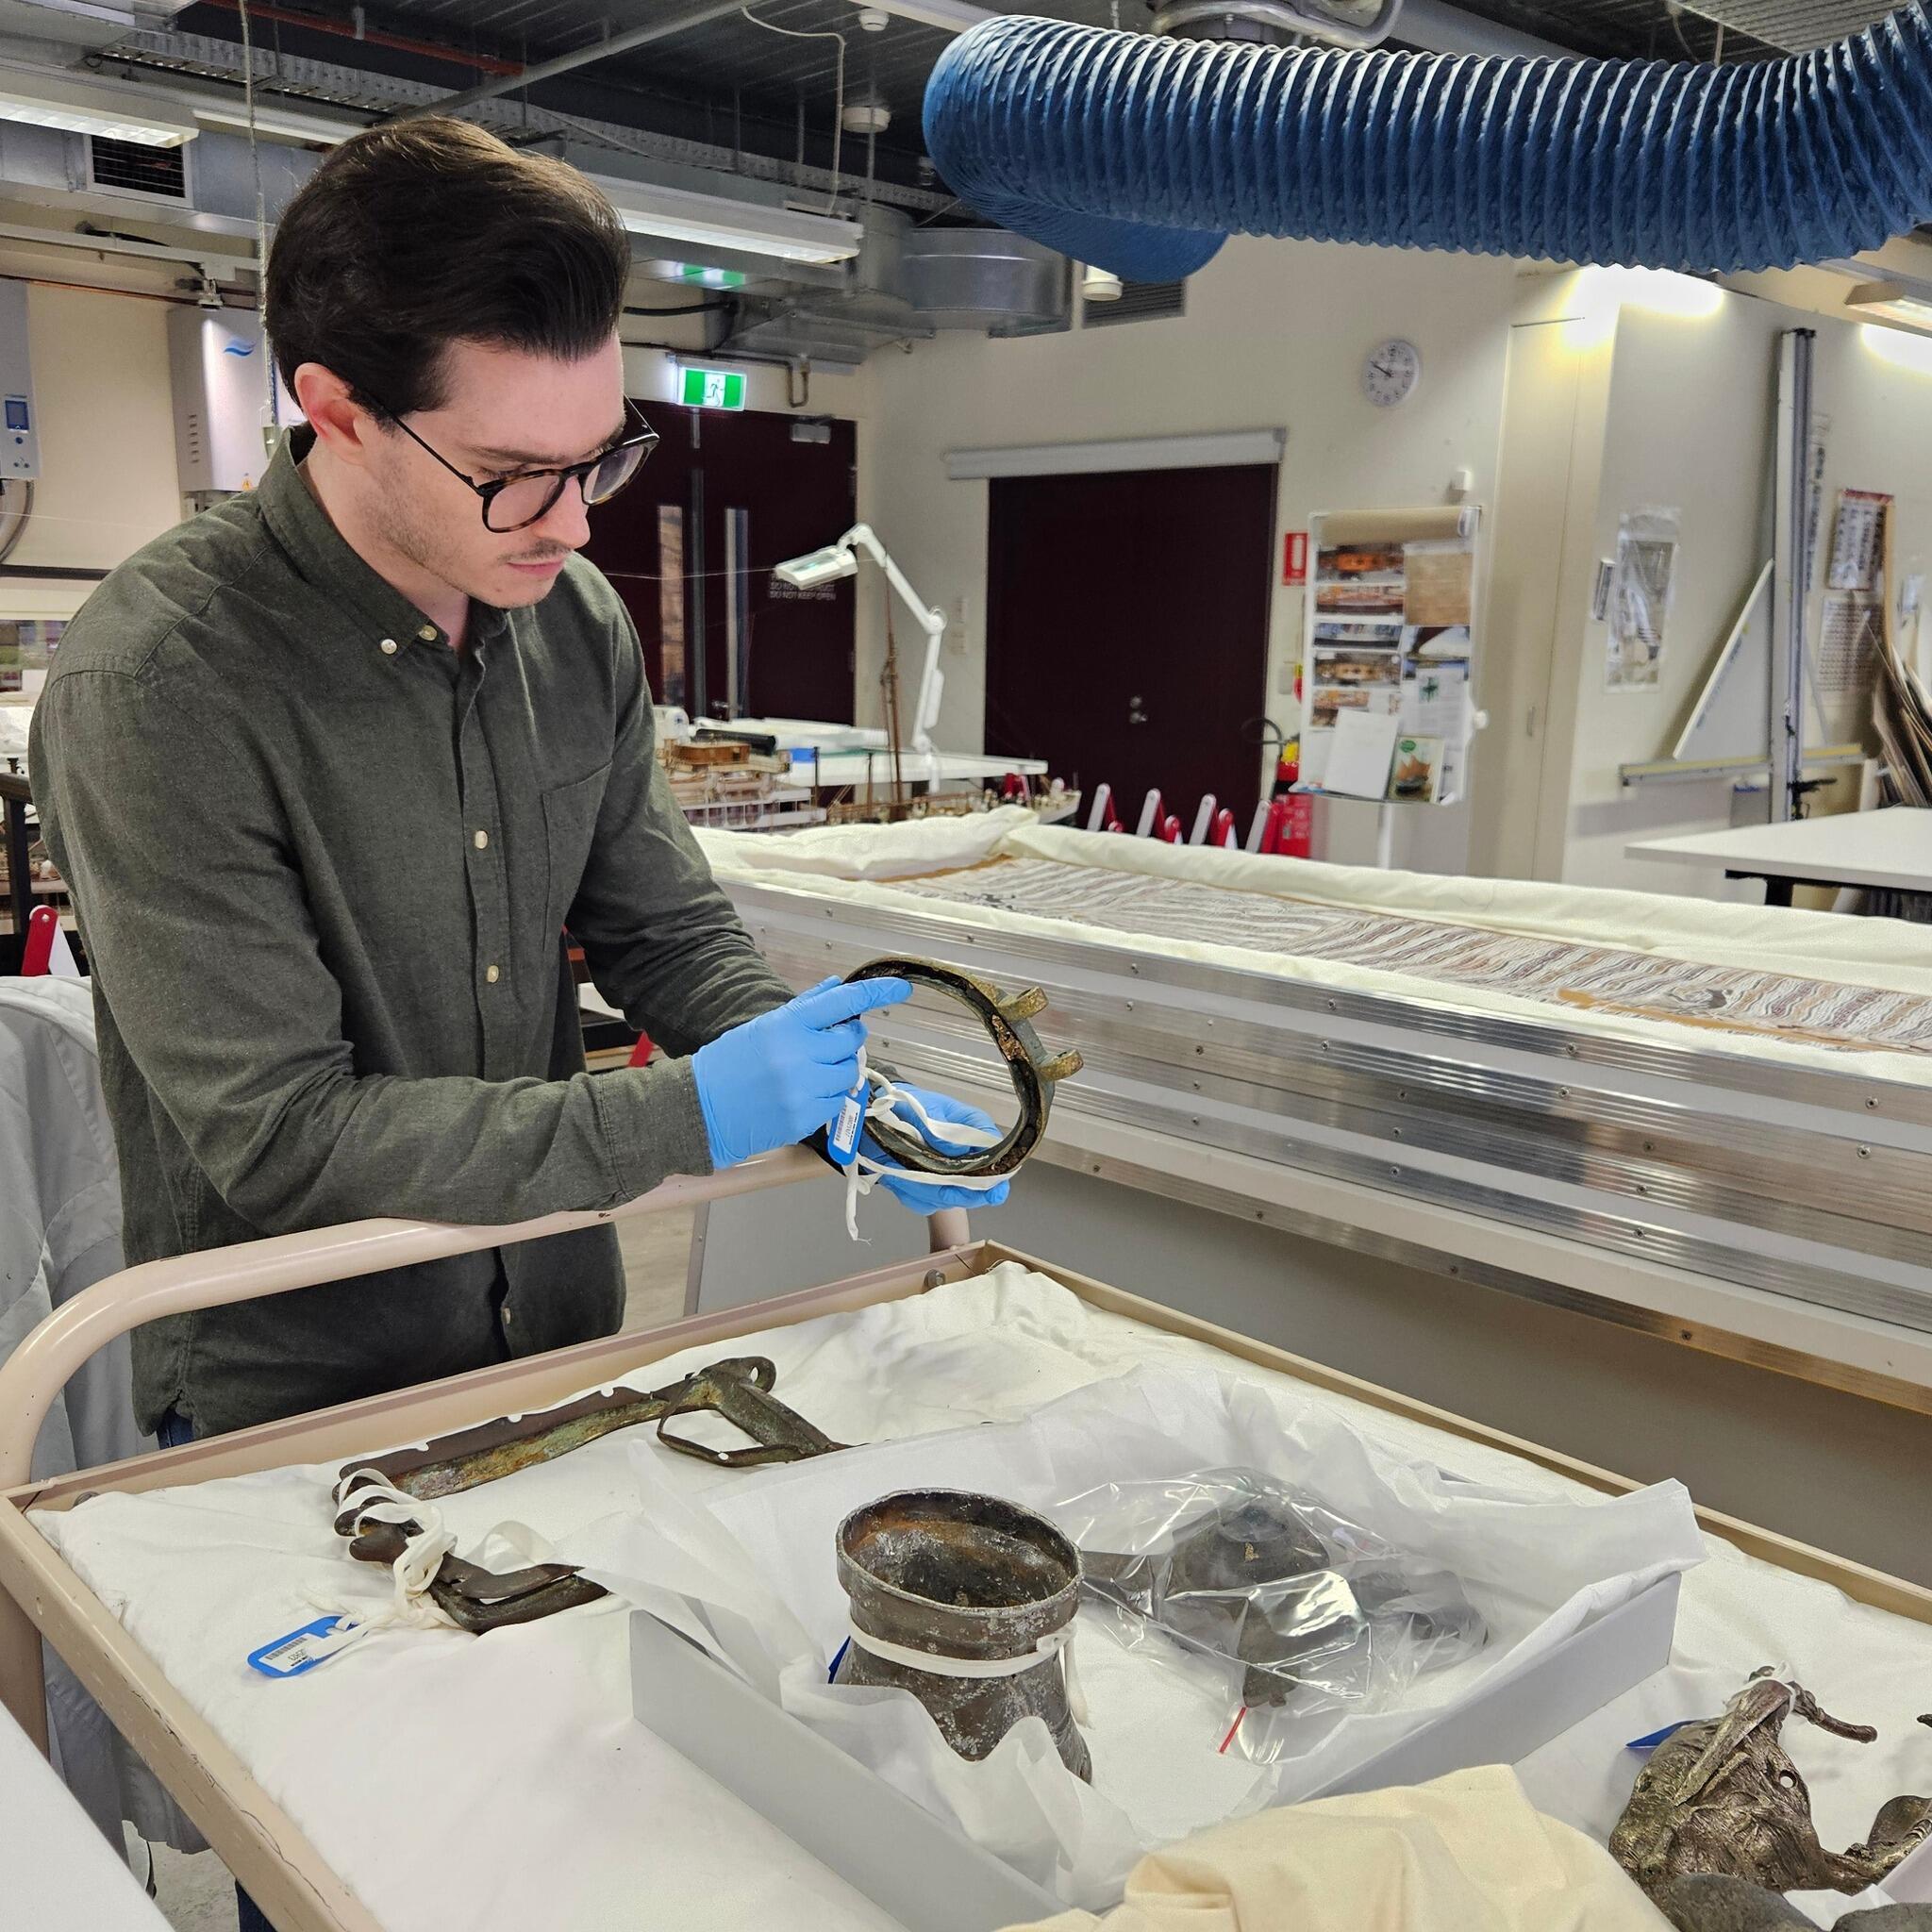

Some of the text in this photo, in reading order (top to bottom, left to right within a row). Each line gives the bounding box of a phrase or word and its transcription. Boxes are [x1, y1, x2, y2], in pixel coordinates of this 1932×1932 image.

[770, 590, 836, 601] DO NOT KEEP OPEN
